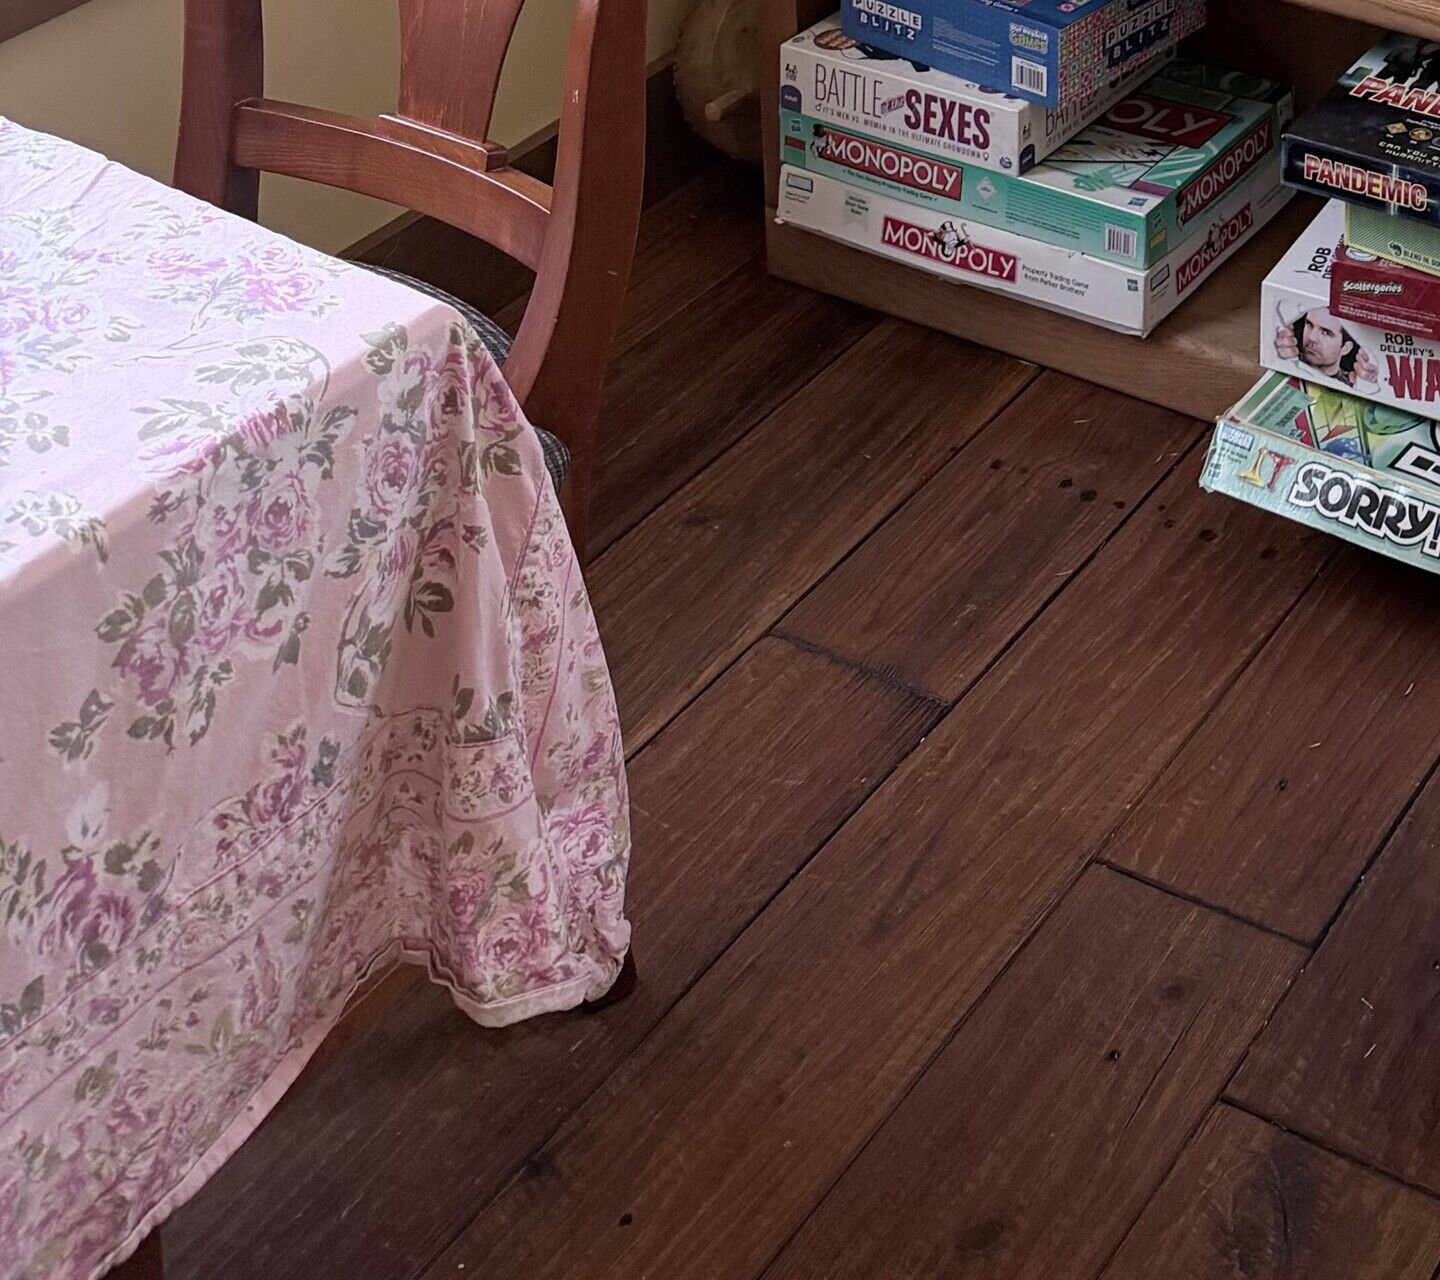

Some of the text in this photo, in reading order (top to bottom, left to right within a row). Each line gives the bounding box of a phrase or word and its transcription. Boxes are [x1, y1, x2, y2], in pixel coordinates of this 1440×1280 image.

[859, 13, 916, 41] BLITZ
[1113, 17, 1169, 58] BLITZ
[815, 63, 991, 151] BATTLE SEXES
[911, 132, 942, 149] ULTIMATE
[943, 140, 982, 159] SHOWDOWN
[1378, 141, 1402, 151] CAN
[1406, 148, 1428, 158] YOU
[827, 133, 958, 192] MONOPOLY
[1185, 124, 1269, 216] MONOPOLY
[1303, 153, 1429, 212] PANDEMIC
[1307, 246, 1332, 274] ROB
[1071, 276, 1090, 289] Game
[1342, 280, 1404, 296] Scattergories
[1379, 343, 1435, 358] DELANEY'S
[1384, 332, 1414, 346] ROB
